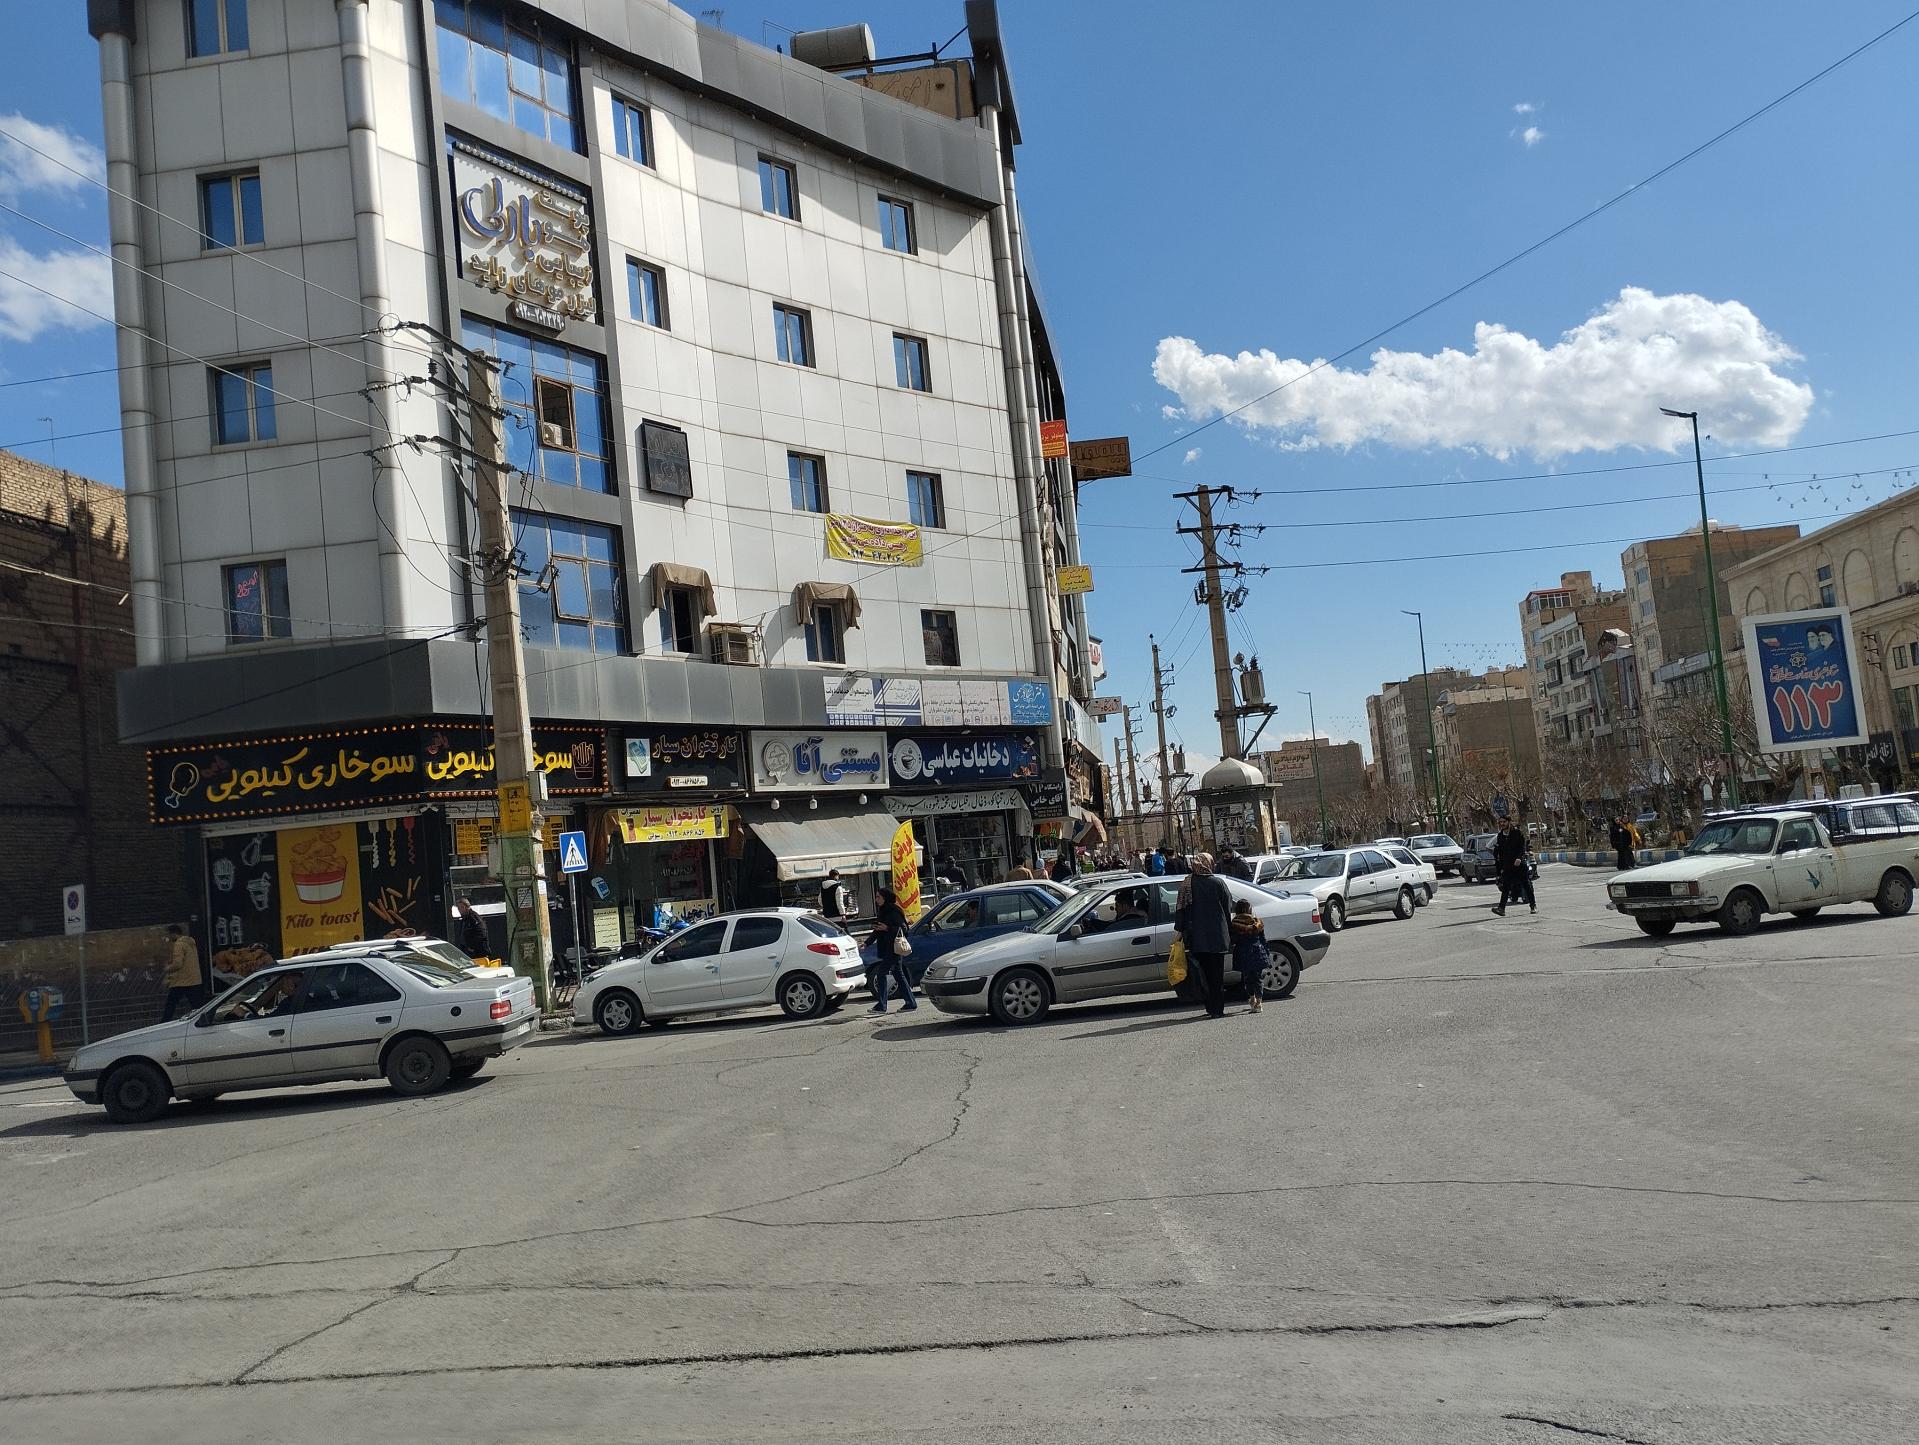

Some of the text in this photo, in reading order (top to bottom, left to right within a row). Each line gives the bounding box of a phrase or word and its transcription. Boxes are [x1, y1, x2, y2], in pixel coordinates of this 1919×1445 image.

[1773, 680, 1843, 733] ۱۱۳
[652, 731, 738, 763] کارتخوان سیار
[793, 735, 881, 784] بستنی آنا
[922, 741, 1011, 778] دخانیات عباسی
[206, 747, 308, 803] کیلویی
[298, 749, 415, 790] سوخاری
[642, 808, 662, 828] سیار
[286, 907, 360, 930] Kilo toast
